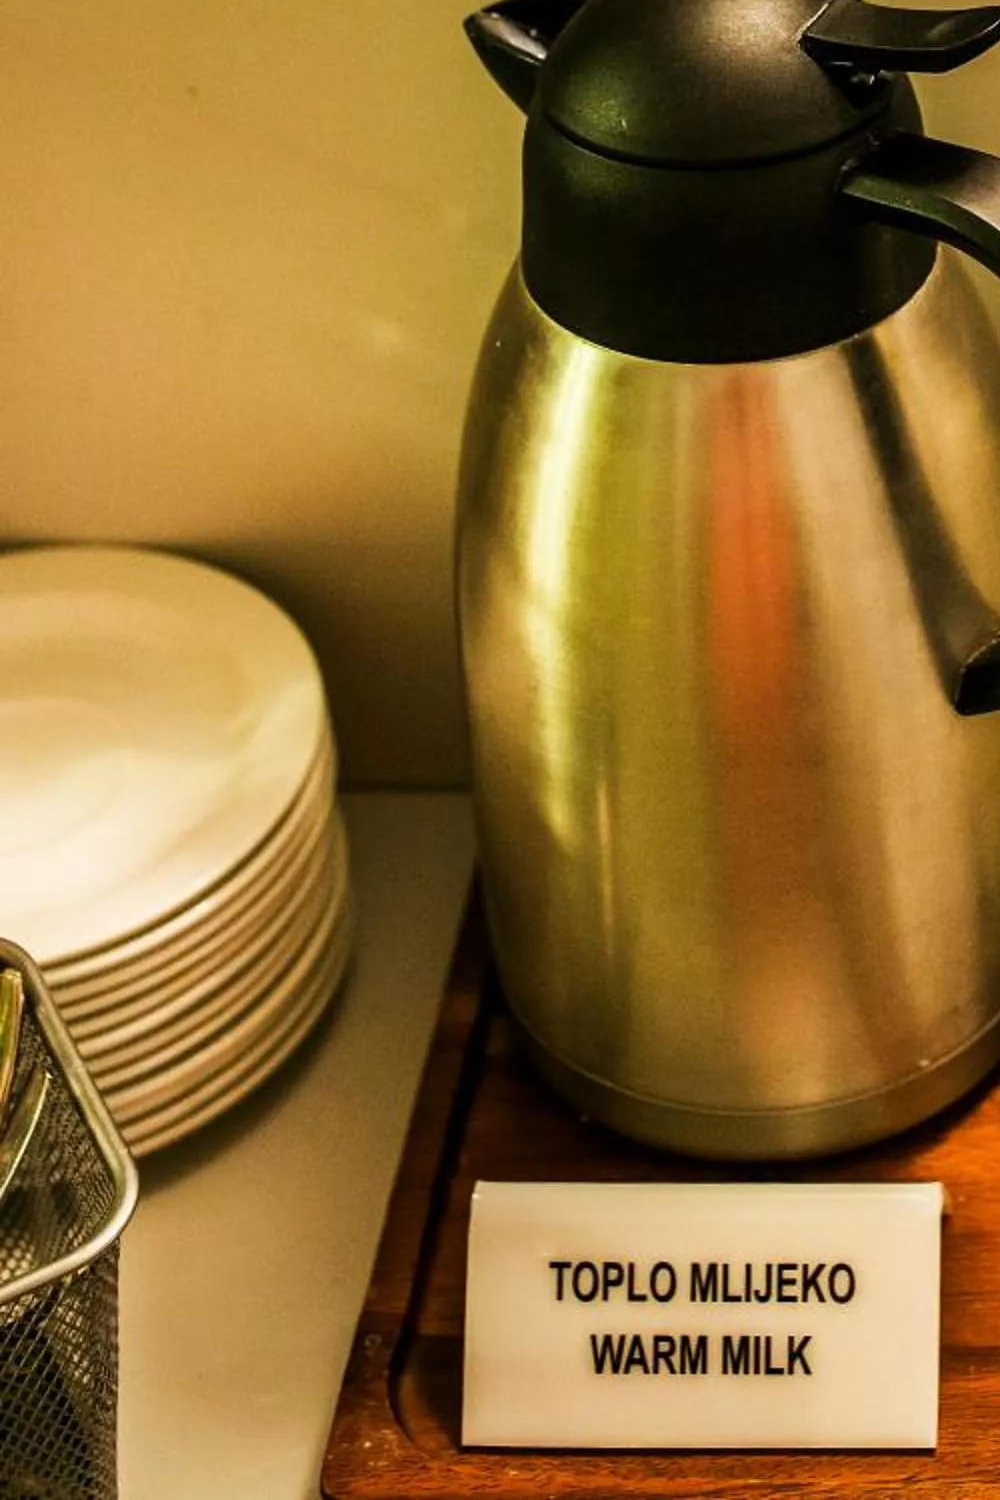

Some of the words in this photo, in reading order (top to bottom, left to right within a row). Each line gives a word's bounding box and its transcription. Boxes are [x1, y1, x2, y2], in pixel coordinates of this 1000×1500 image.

[548, 1260, 678, 1304] TOPLO
[689, 1261, 856, 1305] MLIJEKO
[590, 1333, 709, 1376] WARM
[720, 1334, 813, 1377] MILK
